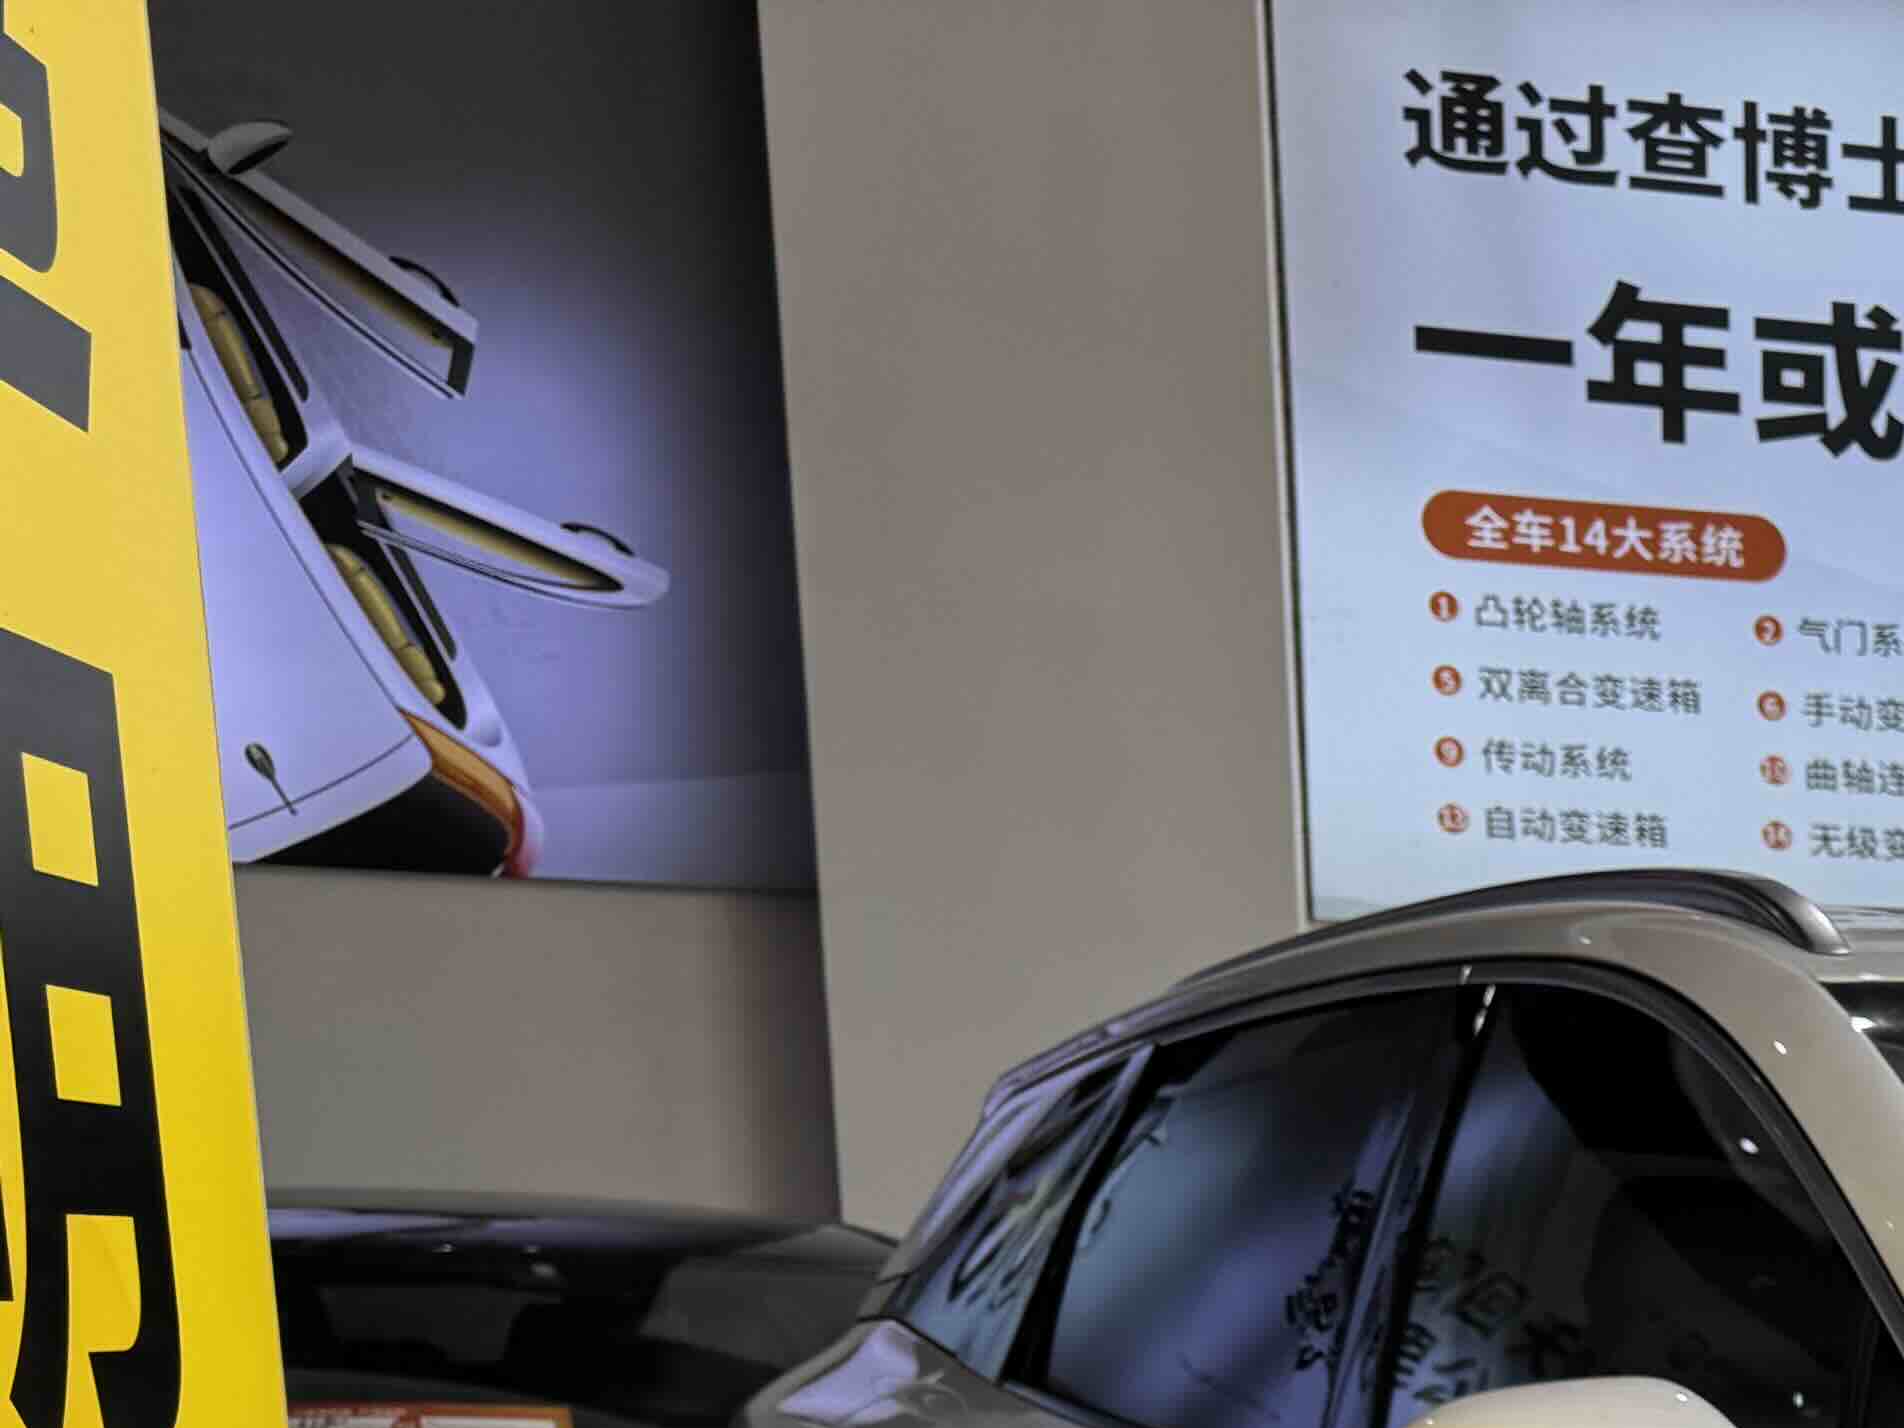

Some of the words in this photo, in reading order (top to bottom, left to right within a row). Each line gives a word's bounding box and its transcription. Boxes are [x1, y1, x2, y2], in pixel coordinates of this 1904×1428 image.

[1464, 505, 1745, 568] 全车14大系统
[1475, 594, 1660, 642] 凸轮轴系统
[1479, 667, 1701, 716] 双离合变速箱
[1482, 740, 1632, 782] 传动系统
[1485, 806, 1668, 849] 自动变速箱
